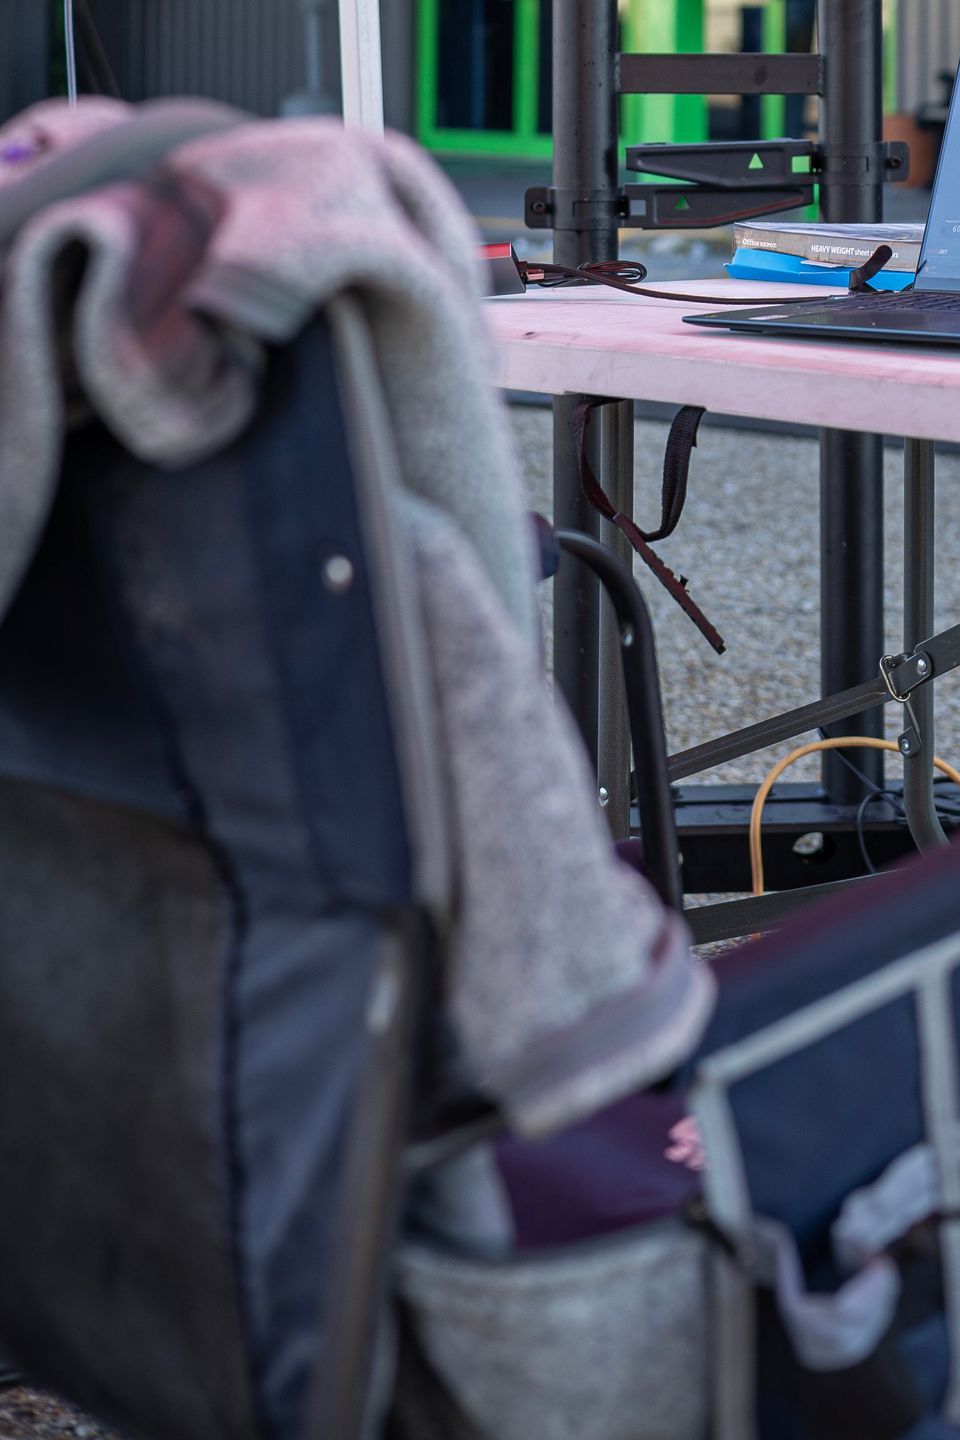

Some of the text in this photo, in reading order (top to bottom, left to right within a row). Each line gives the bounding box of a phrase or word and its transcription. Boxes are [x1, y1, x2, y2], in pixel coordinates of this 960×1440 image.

[953, 225, 960, 233] 60
[742, 238, 759, 247] Office
[811, 244, 831, 254] HEAVY
[831, 246, 854, 256] WEIGHT
[854, 249, 869, 257] sheet
